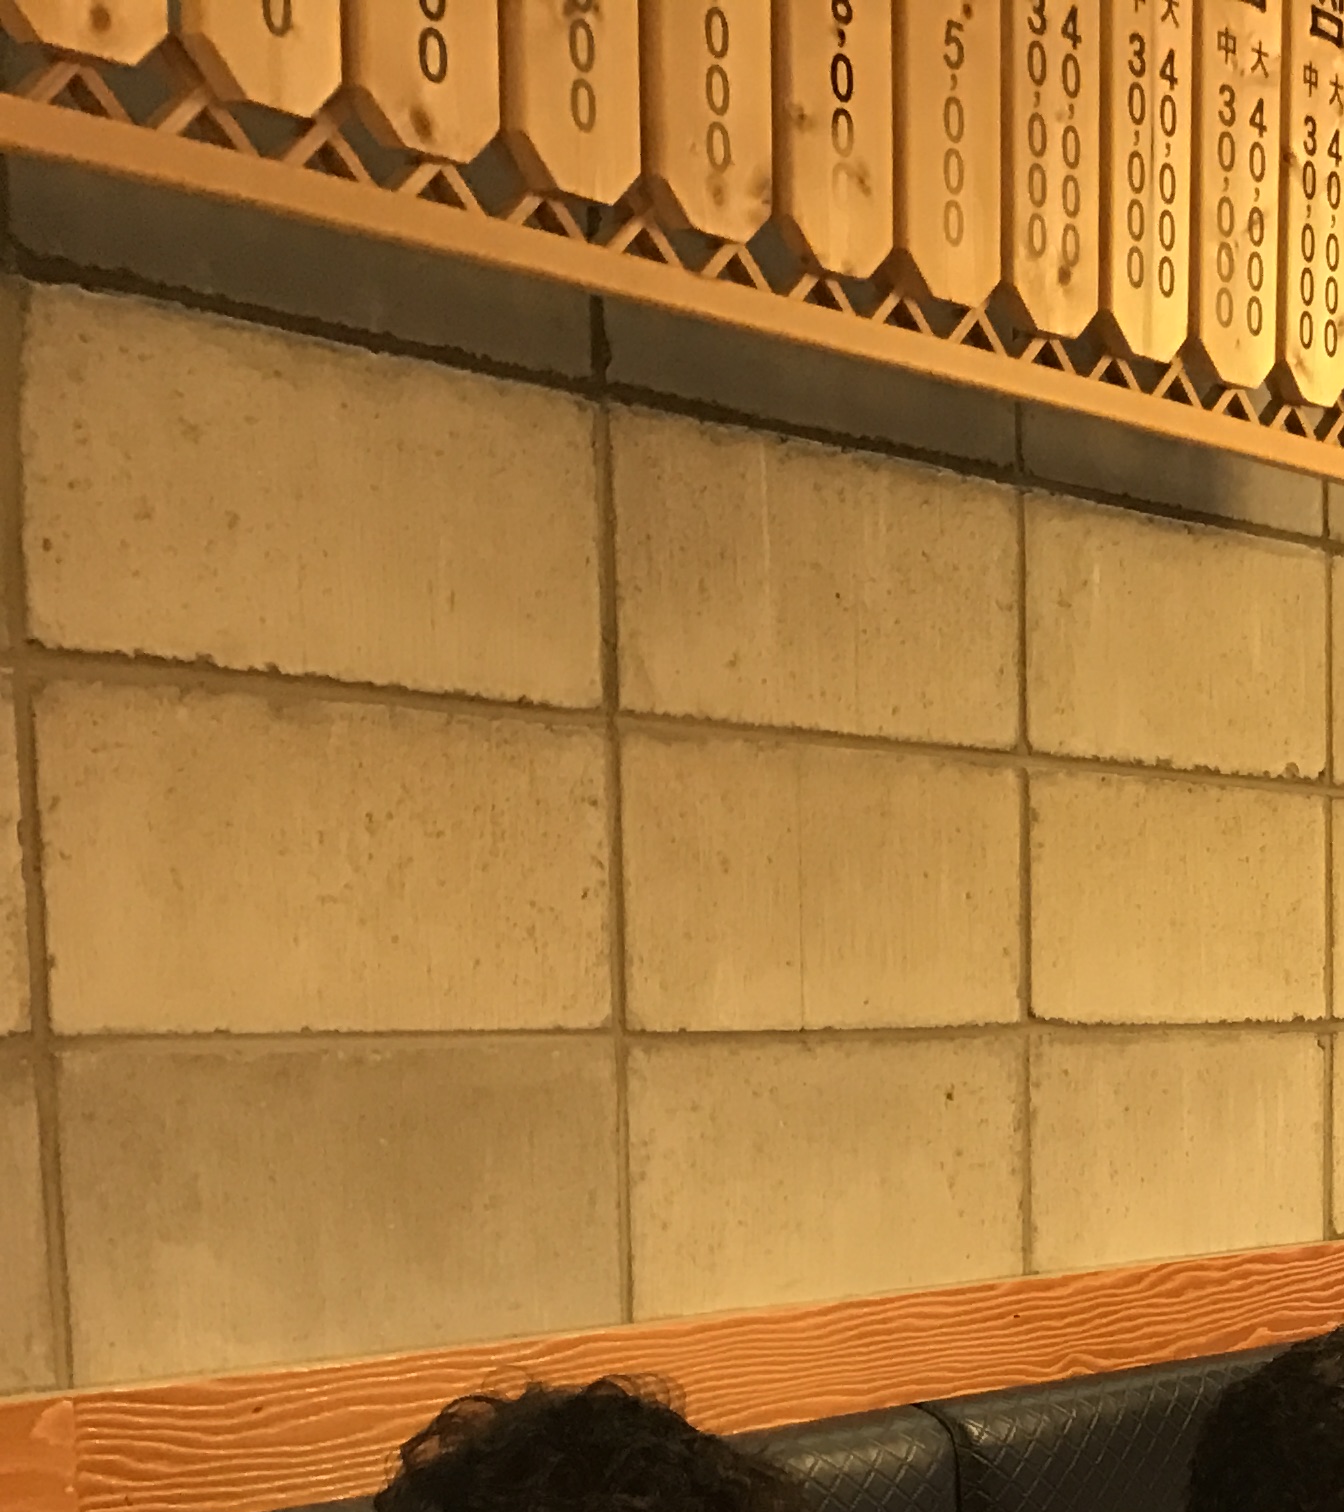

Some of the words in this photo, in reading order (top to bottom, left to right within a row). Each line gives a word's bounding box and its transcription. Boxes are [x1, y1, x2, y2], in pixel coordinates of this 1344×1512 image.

[568, 0, 596, 133] 00
[943, 18, 965, 248] 5,000
[1027, 0, 1047, 259] 30,000
[1061, 4, 1082, 268] 40,000
[1127, 32, 1146, 290] 30,000
[1217, 26, 1237, 65] 中
[1250, 39, 1270, 79] 大
[1303, 60, 1319, 98] 中
[1329, 73, 1344, 110] 大
[1158, 48, 1178, 298] 40,000
[1216, 83, 1237, 329] 30,000
[1246, 97, 1268, 337] 40,000
[1299, 115, 1318, 350] 30,000
[1324, 128, 1342, 358] 40,000
